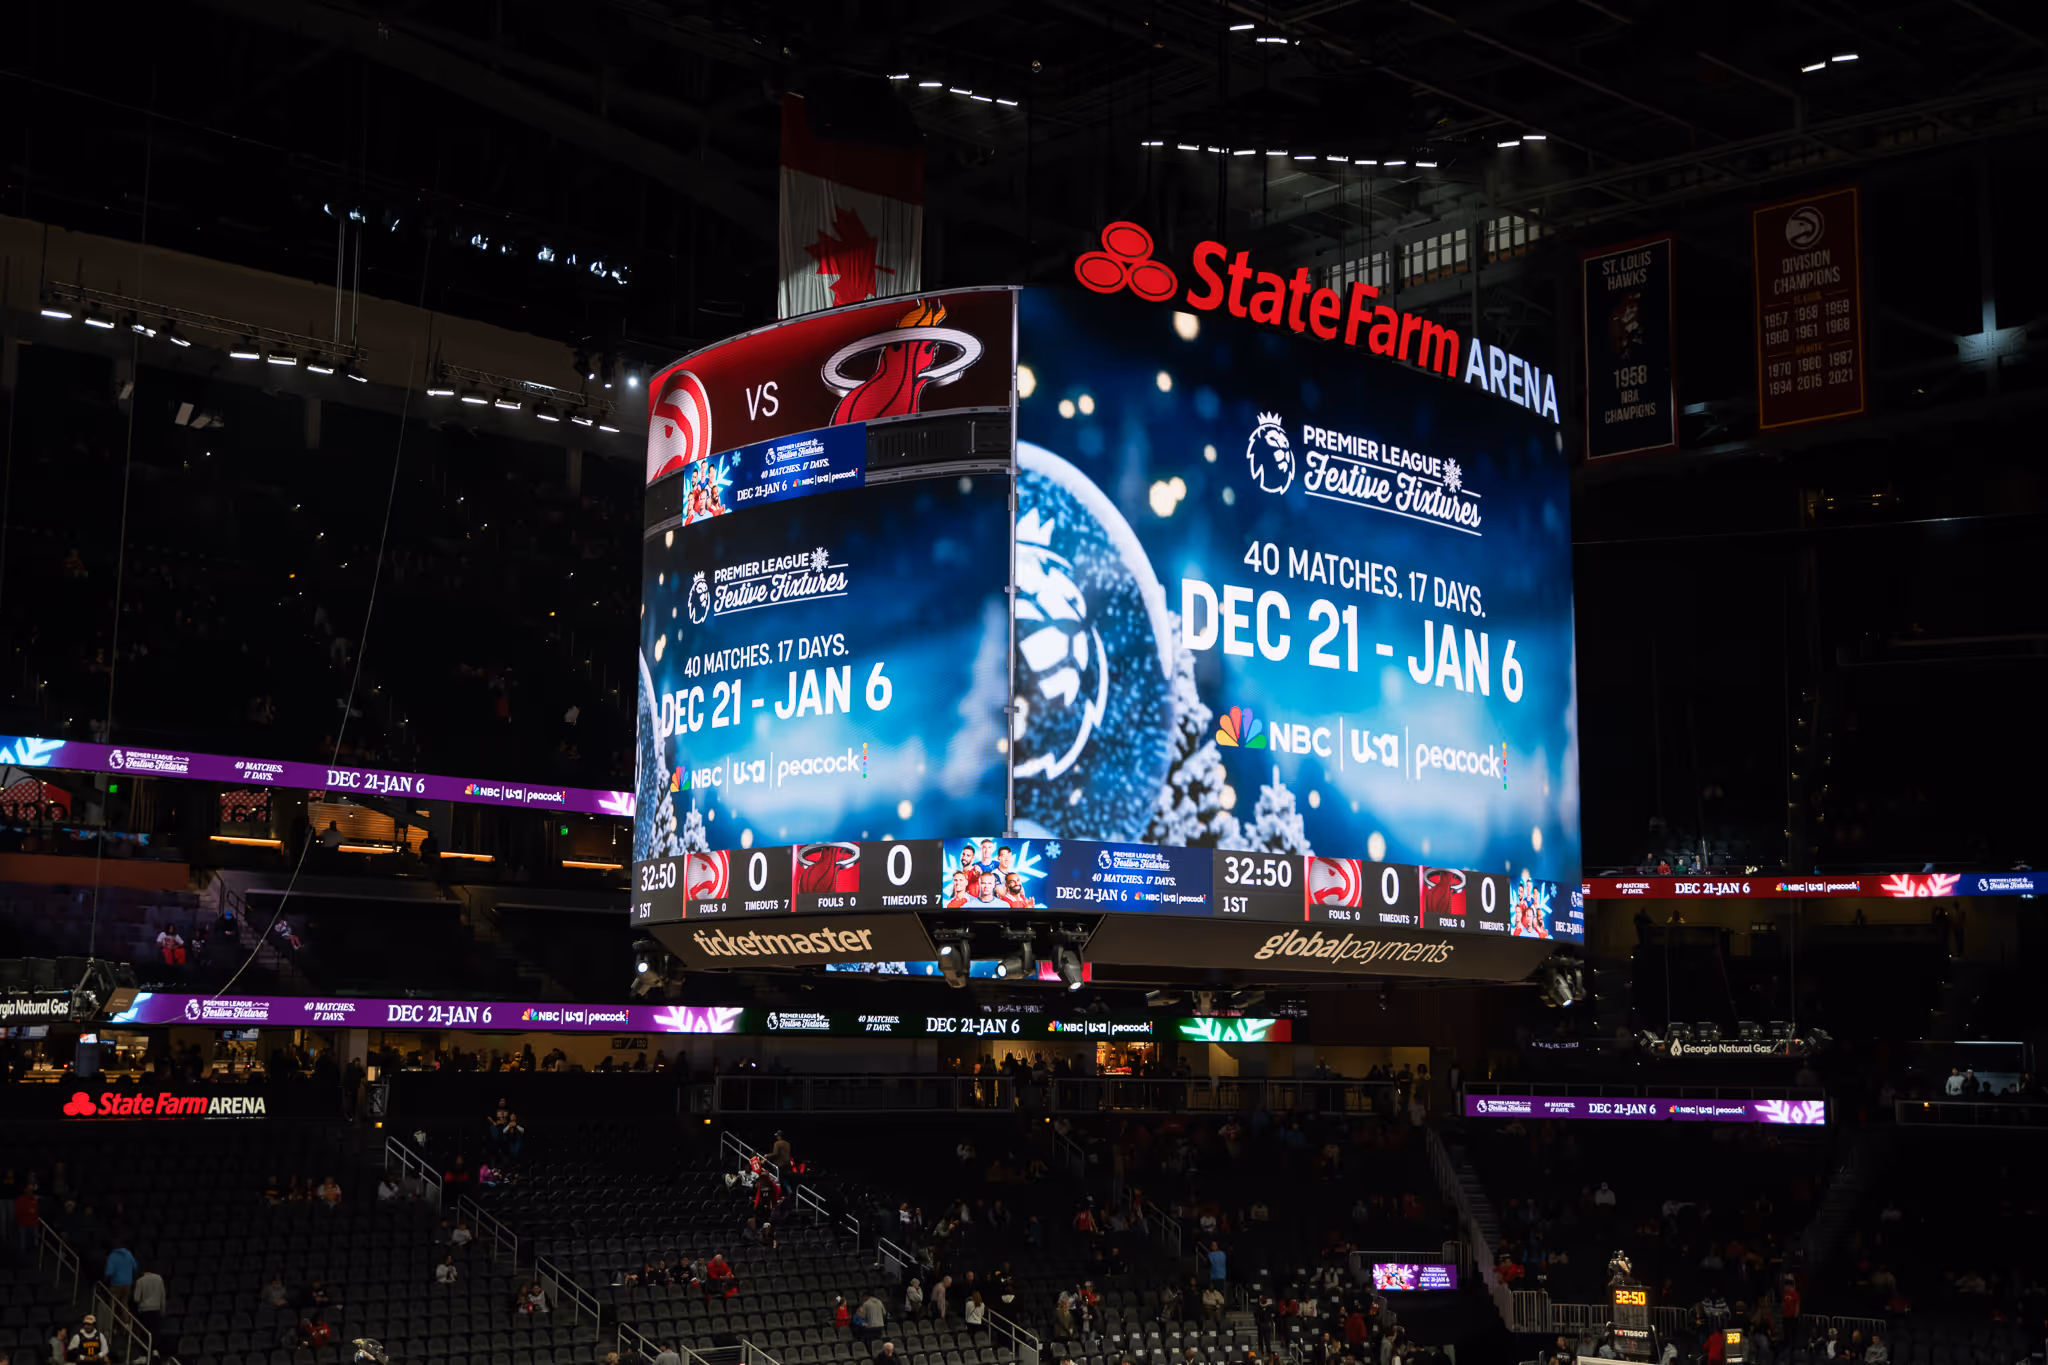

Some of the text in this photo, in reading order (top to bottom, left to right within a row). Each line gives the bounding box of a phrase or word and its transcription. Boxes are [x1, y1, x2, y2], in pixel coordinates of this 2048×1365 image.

[1602, 251, 1651, 276] ST. LOUIS
[1782, 248, 1831, 274] DIVISION
[1608, 268, 1647, 291] HAWKS
[1774, 265, 1840, 296] CHAMPIONS
[1765, 311, 1788, 329] 1957
[1826, 299, 1849, 316] 1959
[1796, 322, 1817, 340] 1961
[1768, 361, 1791, 378] 1970
[1829, 349, 1853, 367] 1987
[1465, 338, 1560, 424] ARENA
[1613, 364, 1648, 388] 1958
[1829, 368, 1853, 384] 2021
[746, 381, 778, 420] VS
[1621, 388, 1639, 403] NBA
[1605, 402, 1656, 424] CHAMPIONS
[1303, 424, 1442, 478] PREMIER LEAGUE
[761, 458, 829, 479] 40 MATCHES. 17 DAYS.
[802, 471, 855, 486] NBC peacock
[737, 487, 753, 501] DEC
[782, 480, 787, 490] 6
[1304, 451, 1481, 527] Festive Fixtures
[714, 553, 809, 583] PREMIER LEAGUE
[1244, 541, 1486, 618] 40 MATCHES. 17 DAYS.
[714, 572, 848, 613] Festive Fixtures
[1182, 578, 1523, 703] DEC 21 - JAN 6
[685, 633, 849, 678] 40 MATCHES. 17 DAYS.
[661, 662, 892, 737] DEC 21 - JAN 6
[1270, 721, 1331, 757] NBC
[1416, 742, 1500, 780] peacock
[234, 762, 283, 772] 40 MATCHES.
[691, 767, 722, 789] NBC
[778, 747, 859, 787] peacock
[252, 772, 273, 781] DAYS.
[327, 770, 360, 787] DEC
[416, 779, 425, 793] 6
[480, 788, 562, 802] NBC peacock
[749, 852, 767, 891] 0
[887, 845, 912, 885] 0
[1113, 858, 1137, 869] Festive
[1224, 856, 1292, 888] 32:50
[641, 862, 676, 891] 32:50
[1092, 873, 1176, 886] 40 MATCHES. 17 DAYS.
[1056, 887, 1127, 902] DEC 21-JAN 6
[1381, 867, 1399, 905] 0
[1675, 883, 1700, 893] DEC
[1743, 883, 1750, 893] 6
[1827, 882, 1857, 892] peacock
[818, 897, 856, 908] FOULS 0
[882, 895, 941, 906] TIMEOUTS 7
[1145, 893, 1204, 904] NBC peacock
[1481, 877, 1496, 913] 0
[640, 903, 651, 918] 1ST
[700, 903, 726, 913] FOULS 0
[745, 899, 789, 910] TIMEOUTS 7
[1223, 896, 1248, 913] 1ST
[1329, 910, 1360, 920] FOULS 0
[1379, 913, 1418, 925] TIMEOUTS 7
[1439, 917, 1465, 928] FOULS 0
[1480, 921, 1504, 931] TIMEOUTS
[693, 927, 872, 956] ticketmaster
[16, 999, 49, 1015] Natural
[51, 998, 68, 1015] Gas
[304, 1002, 355, 1012] 40 MATCHES.
[387, 1004, 423, 1021] DEC
[482, 1007, 492, 1022] 6
[314, 1012, 345, 1021] 17 DAYS.
[538, 1011, 625, 1025] NBC peacock
[926, 1018, 956, 1032] DEC
[1011, 1019, 1020, 1033] 6
[1064, 1022, 1149, 1035] NBC peacock
[1683, 1044, 1771, 1054] Georgia Natural Gas
[208, 1097, 265, 1114] ARENA
[1588, 1103, 1612, 1113] DEC
[1650, 1104, 1656, 1114] 6
[1716, 1106, 1742, 1115] peacock
[1616, 1290, 1646, 1305] 32:50
